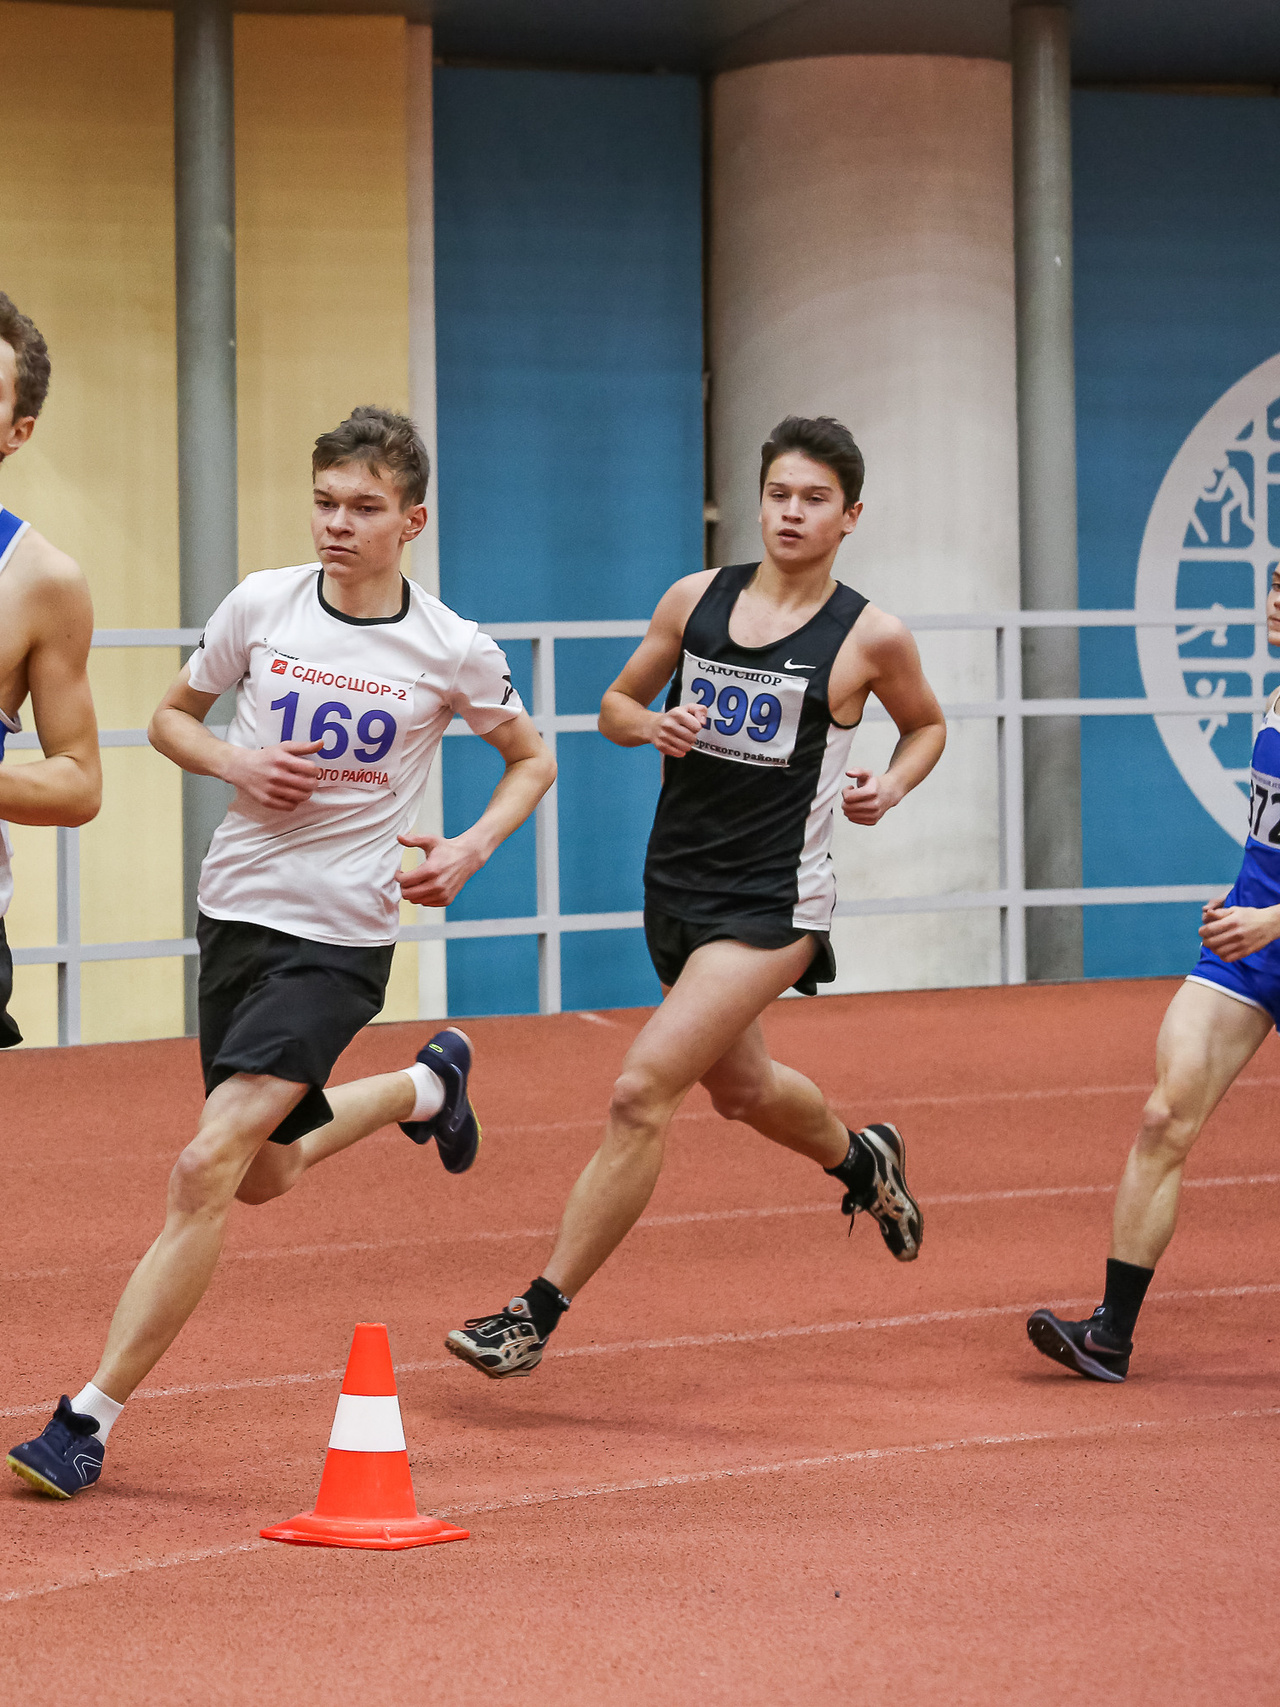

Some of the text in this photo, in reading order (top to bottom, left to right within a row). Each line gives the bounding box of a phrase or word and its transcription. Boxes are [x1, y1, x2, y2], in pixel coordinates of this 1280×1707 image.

[292, 665, 408, 701] СДЮСШОР-2
[697, 661, 783, 687] СДЮСШОР
[270, 690, 398, 763] 169
[690, 677, 783, 743] 299
[340, 768, 389, 785] РАЙОНА
